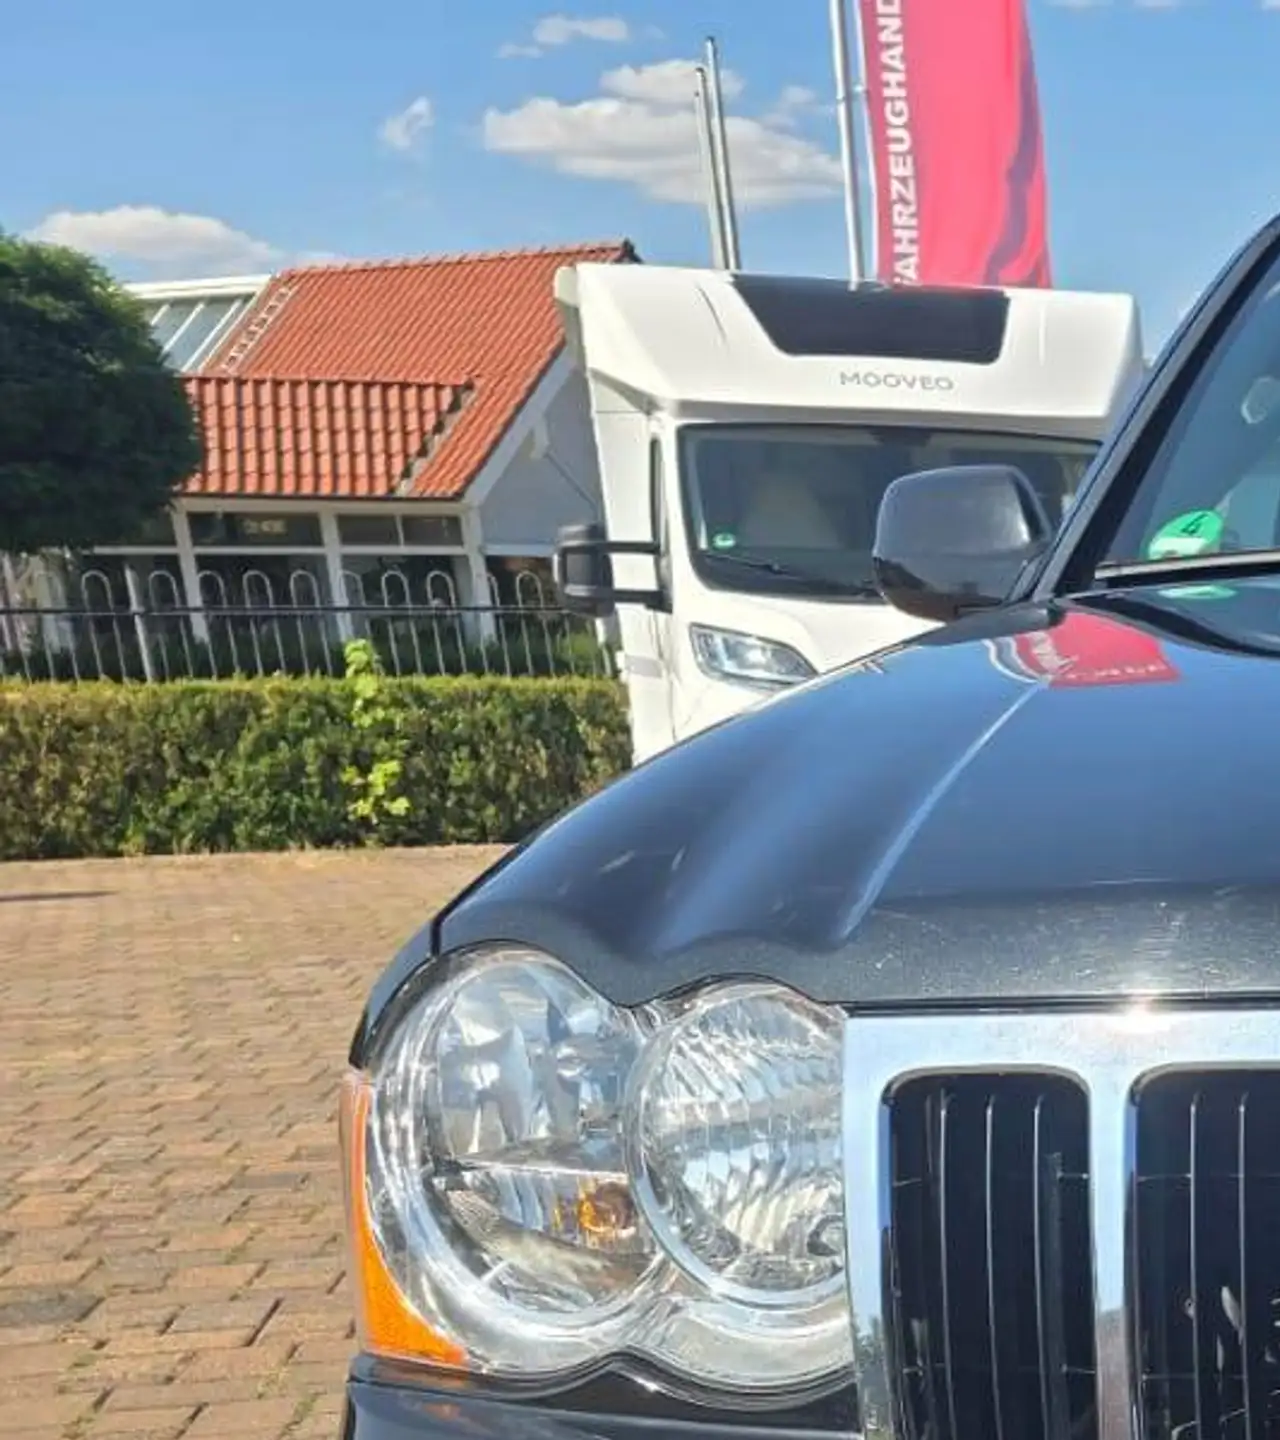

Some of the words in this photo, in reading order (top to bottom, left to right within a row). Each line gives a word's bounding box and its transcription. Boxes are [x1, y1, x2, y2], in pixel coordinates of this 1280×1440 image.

[877, 0, 919, 285] AHRZEUGHAND
[840, 371, 954, 390] MOOVEO
[1181, 513, 1209, 534] 4
